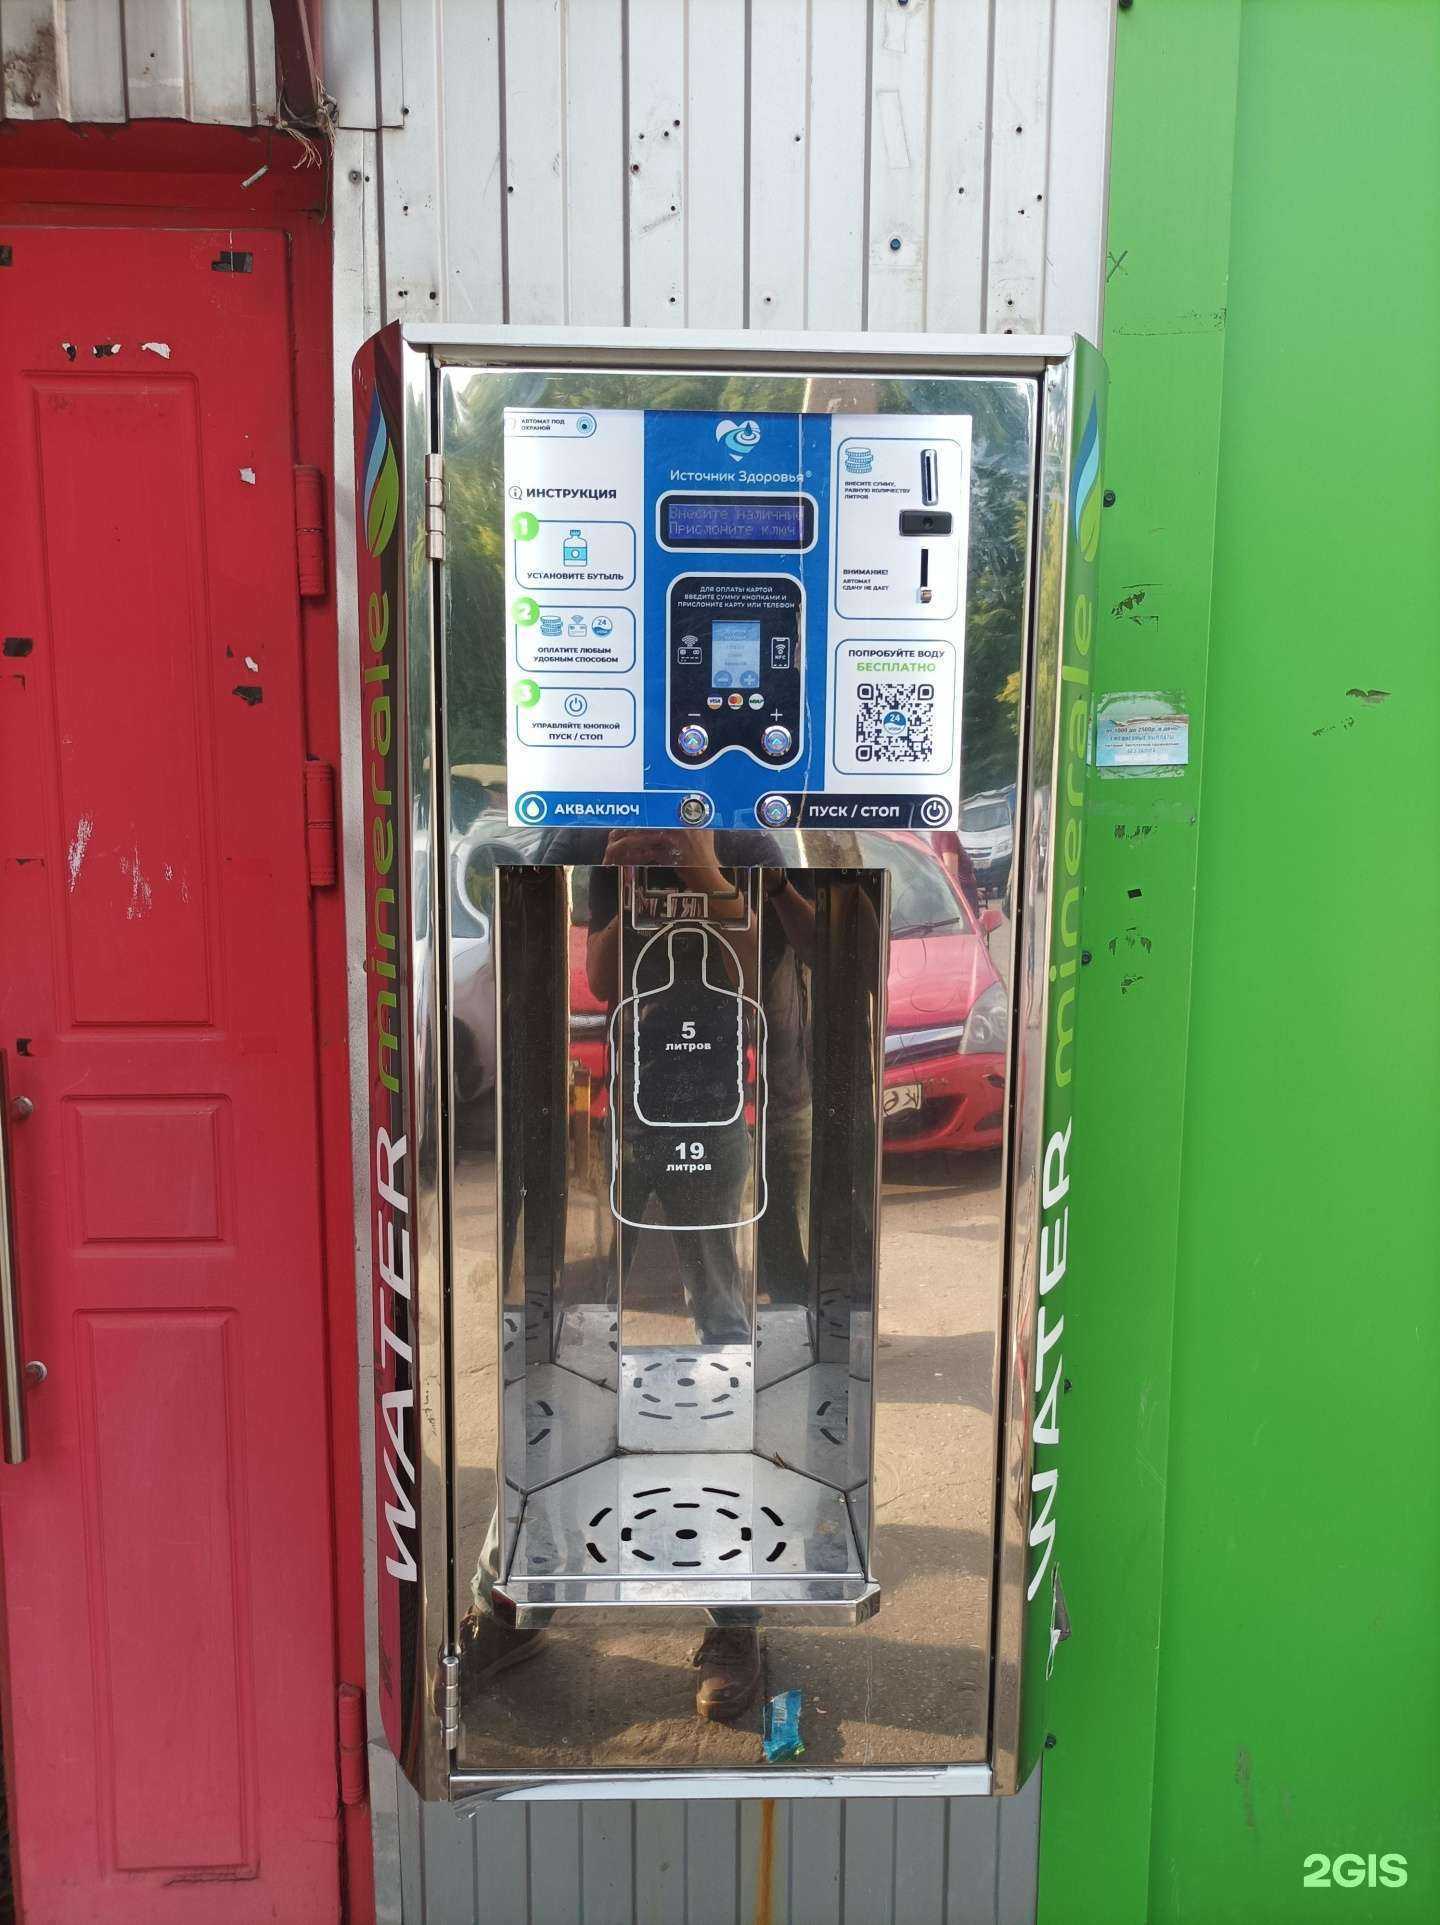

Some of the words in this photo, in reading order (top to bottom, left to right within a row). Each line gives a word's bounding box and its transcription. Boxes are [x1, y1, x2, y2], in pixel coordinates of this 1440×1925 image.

[670, 469, 735, 482] Источник
[526, 488, 617, 501] ИНСТРУКЦИЯ
[669, 505, 729, 520] Внесите
[669, 521, 753, 537] Прислоните
[760, 524, 796, 537] ключ
[527, 572, 585, 580] УСТАНОВИТЕ
[587, 572, 624, 581] БУТЫЛЬ
[848, 648, 915, 658] ПОПРОБУЙТЕ
[917, 650, 945, 659] ВОДУ
[856, 662, 936, 673] БЕСПЛАТНО
[889, 714, 901, 722] 24
[579, 733, 603, 741] СТОП
[554, 803, 640, 816] АКВАКЛЮЧ
[809, 805, 848, 817] ПУСК
[850, 804, 858, 819] /
[860, 806, 900, 818] СТОП
[364, 591, 399, 1094] minerale
[1049, 593, 1092, 1089] minerale
[680, 1021, 696, 1040] 5
[665, 1042, 712, 1053] литров
[675, 1142, 705, 1160] 19
[665, 1163, 712, 1173] литров
[377, 1125, 418, 1583] WATER
[1027, 1115, 1073, 1602] WATER
